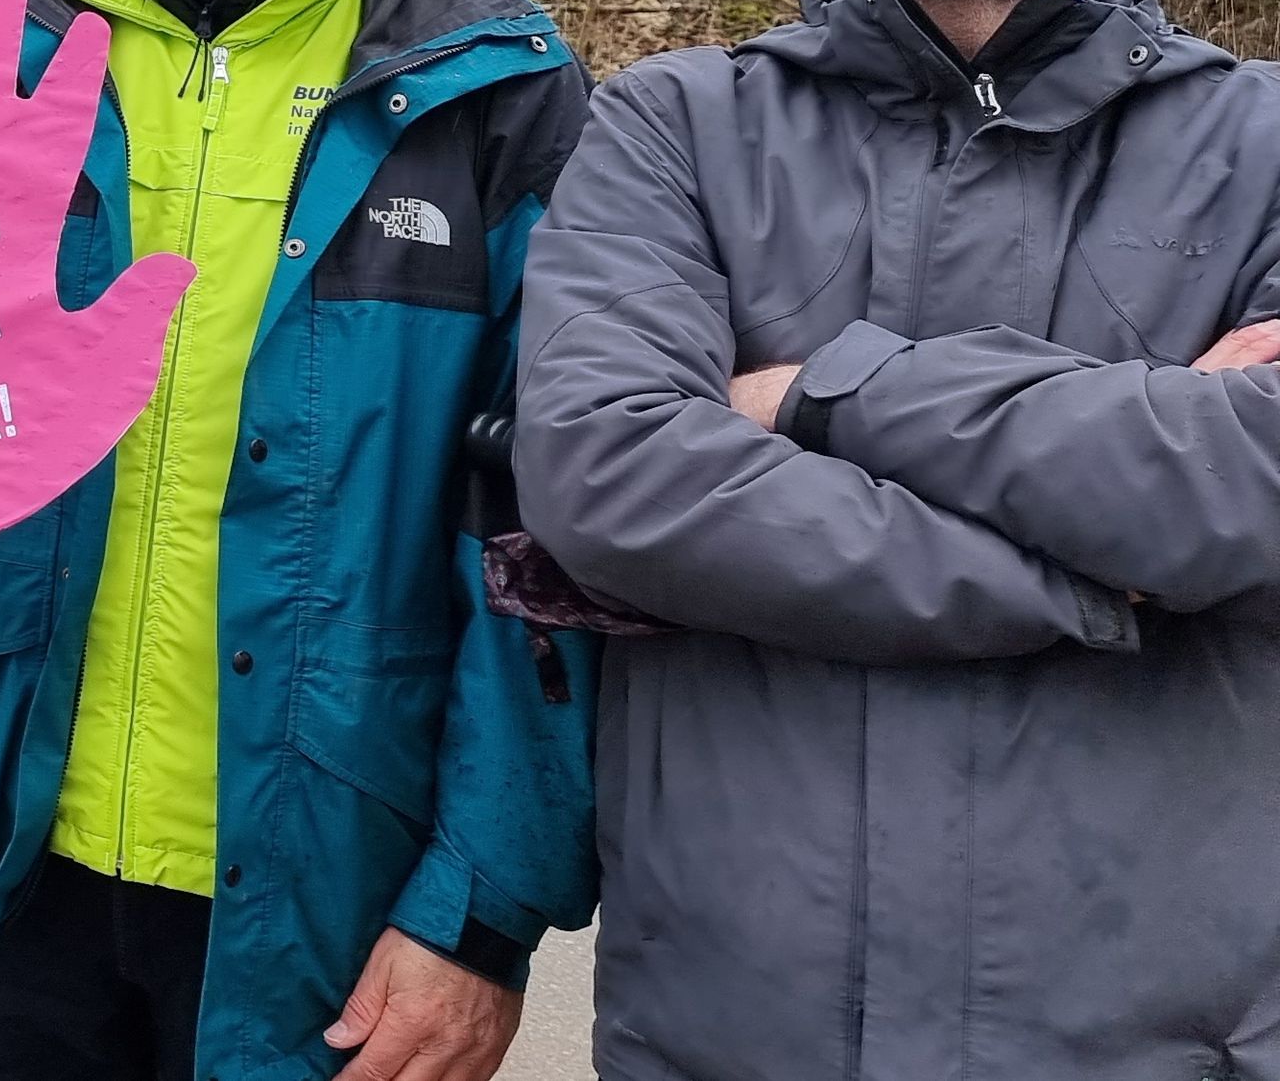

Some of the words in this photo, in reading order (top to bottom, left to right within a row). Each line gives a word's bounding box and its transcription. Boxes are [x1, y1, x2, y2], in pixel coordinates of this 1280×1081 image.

[288, 122, 303, 135] in
[388, 197, 421, 212] THE
[368, 207, 421, 227] NORTH
[383, 223, 421, 241] FACE
